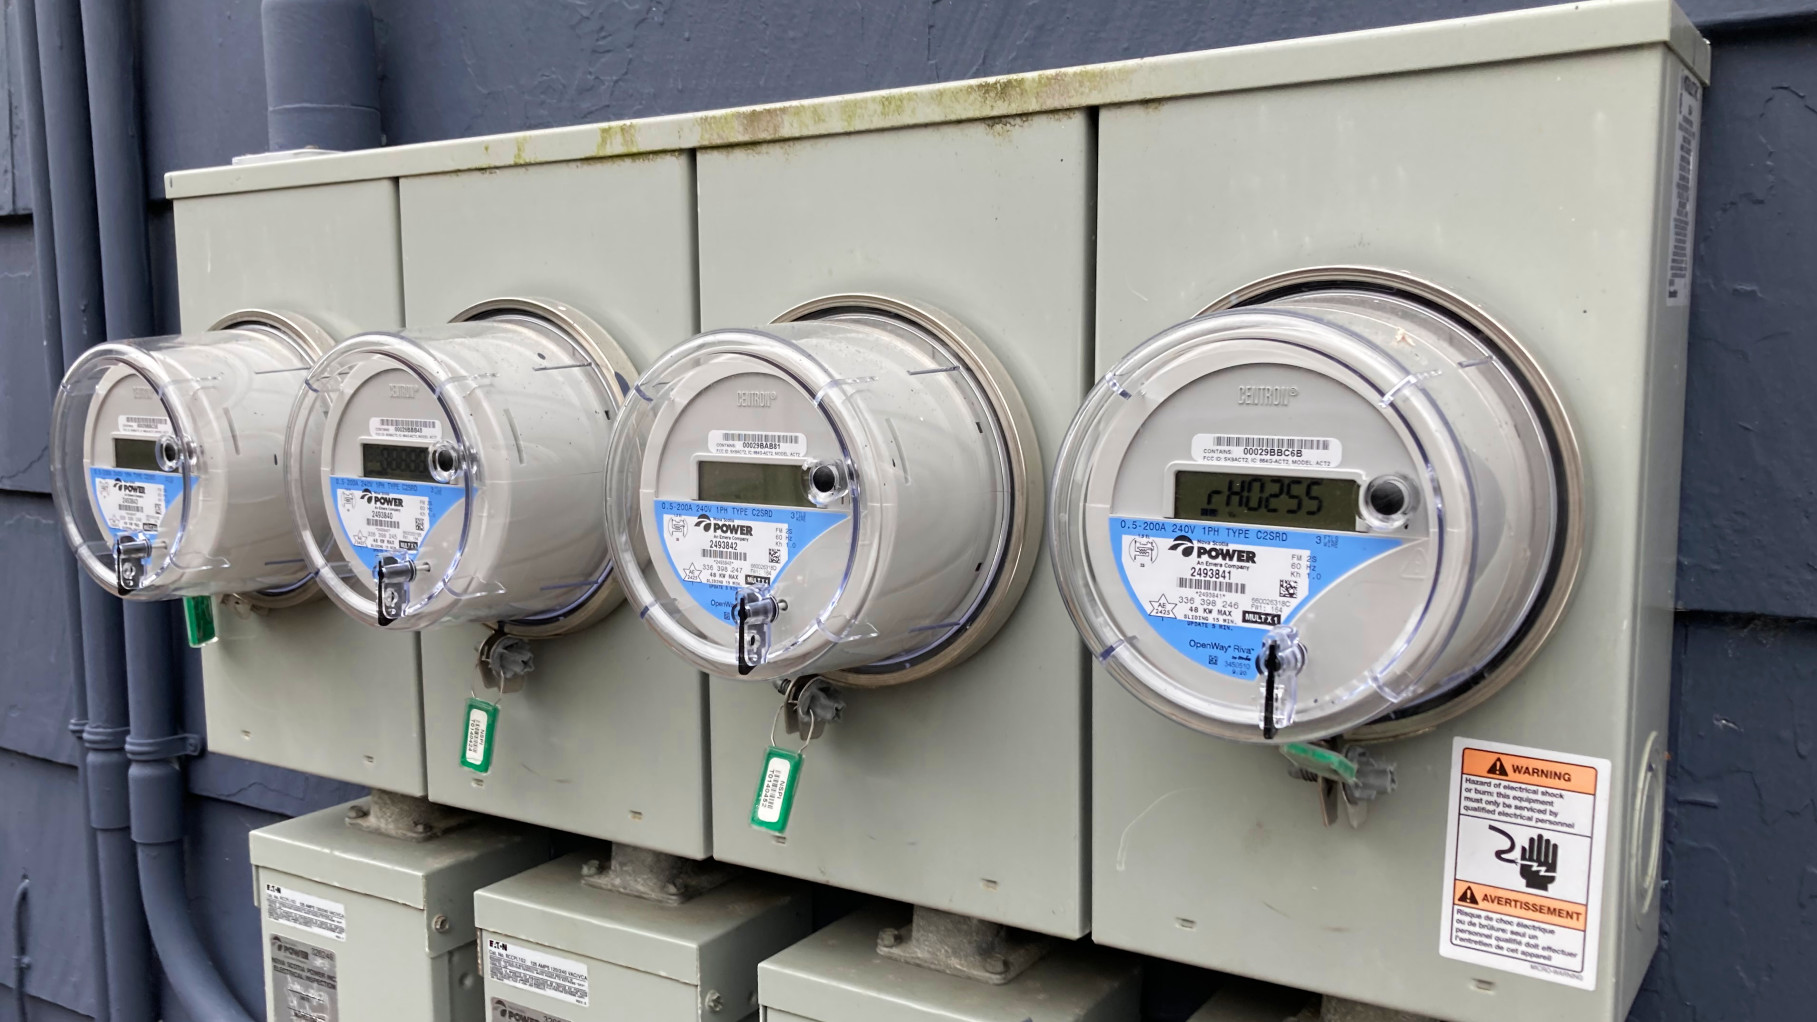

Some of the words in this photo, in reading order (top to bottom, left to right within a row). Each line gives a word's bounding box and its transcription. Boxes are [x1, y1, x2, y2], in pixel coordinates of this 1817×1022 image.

[1243, 447, 1303, 458] 00029BBC6B
[374, 496, 404, 508] POWER
[662, 502, 693, 512] 0.5-200A
[732, 506, 748, 516] TYPE
[713, 523, 753, 536] POWER
[1120, 519, 1167, 531] 0.5-200A
[1172, 524, 1196, 535] 240V
[1202, 526, 1220, 536] 1PH
[1226, 527, 1250, 540] TYPE
[1256, 530, 1288, 542] C2SRD
[710, 539, 738, 550] 2493842
[1316, 535, 1322, 545] 3
[1196, 546, 1257, 564] POWER
[1307, 555, 1317, 563] 2S
[1206, 560, 1224, 568] Emera
[1224, 562, 1250, 571] Company
[1190, 567, 1231, 581] 2493841
[1178, 596, 1195, 605] 336
[1200, 598, 1217, 607] 398
[1222, 600, 1239, 610] 246
[1203, 607, 1213, 615] KW
[1217, 609, 1233, 617] MAX
[1246, 613, 1266, 623] MULT
[1267, 615, 1272, 623] X
[1274, 616, 1278, 624] 1
[1512, 764, 1572, 783] WARNING
[777, 780, 785, 799] NSPI
[1465, 776, 1491, 788] Hazard
[1503, 784, 1539, 795] electrical
[1541, 790, 1565, 800] shock
[1496, 791, 1510, 800] this
[1512, 795, 1554, 808] equipment
[1464, 796, 1483, 805] must
[1485, 798, 1500, 809] only
[1502, 801, 1512, 809] be
[1514, 804, 1548, 817] serviced
[1549, 809, 1559, 819] by
[1463, 804, 1496, 816] qualified
[1498, 810, 1533, 822] electrical
[1535, 817, 1575, 829] personnel
[1482, 893, 1582, 922] AVERTISSEMENT
[1456, 918, 1466, 926] ou
[1468, 919, 1477, 928] de
[1510, 929, 1527, 938] seul
[1528, 933, 1539, 941] un
[1457, 908, 1482, 920] Risque
[1484, 913, 1494, 922] de
[1496, 917, 1514, 927] choc
[1516, 921, 1556, 936] électrique
[1455, 927, 1493, 940] personnel
[1495, 934, 1522, 947] qualifié
[1524, 941, 1540, 951] doit
[1541, 945, 1578, 959] effectuer
[1495, 942, 1505, 951] de
[1506, 946, 1519, 955] cet
[1520, 949, 1552, 962] appareil
[538, 963, 550, 971] AMPS
